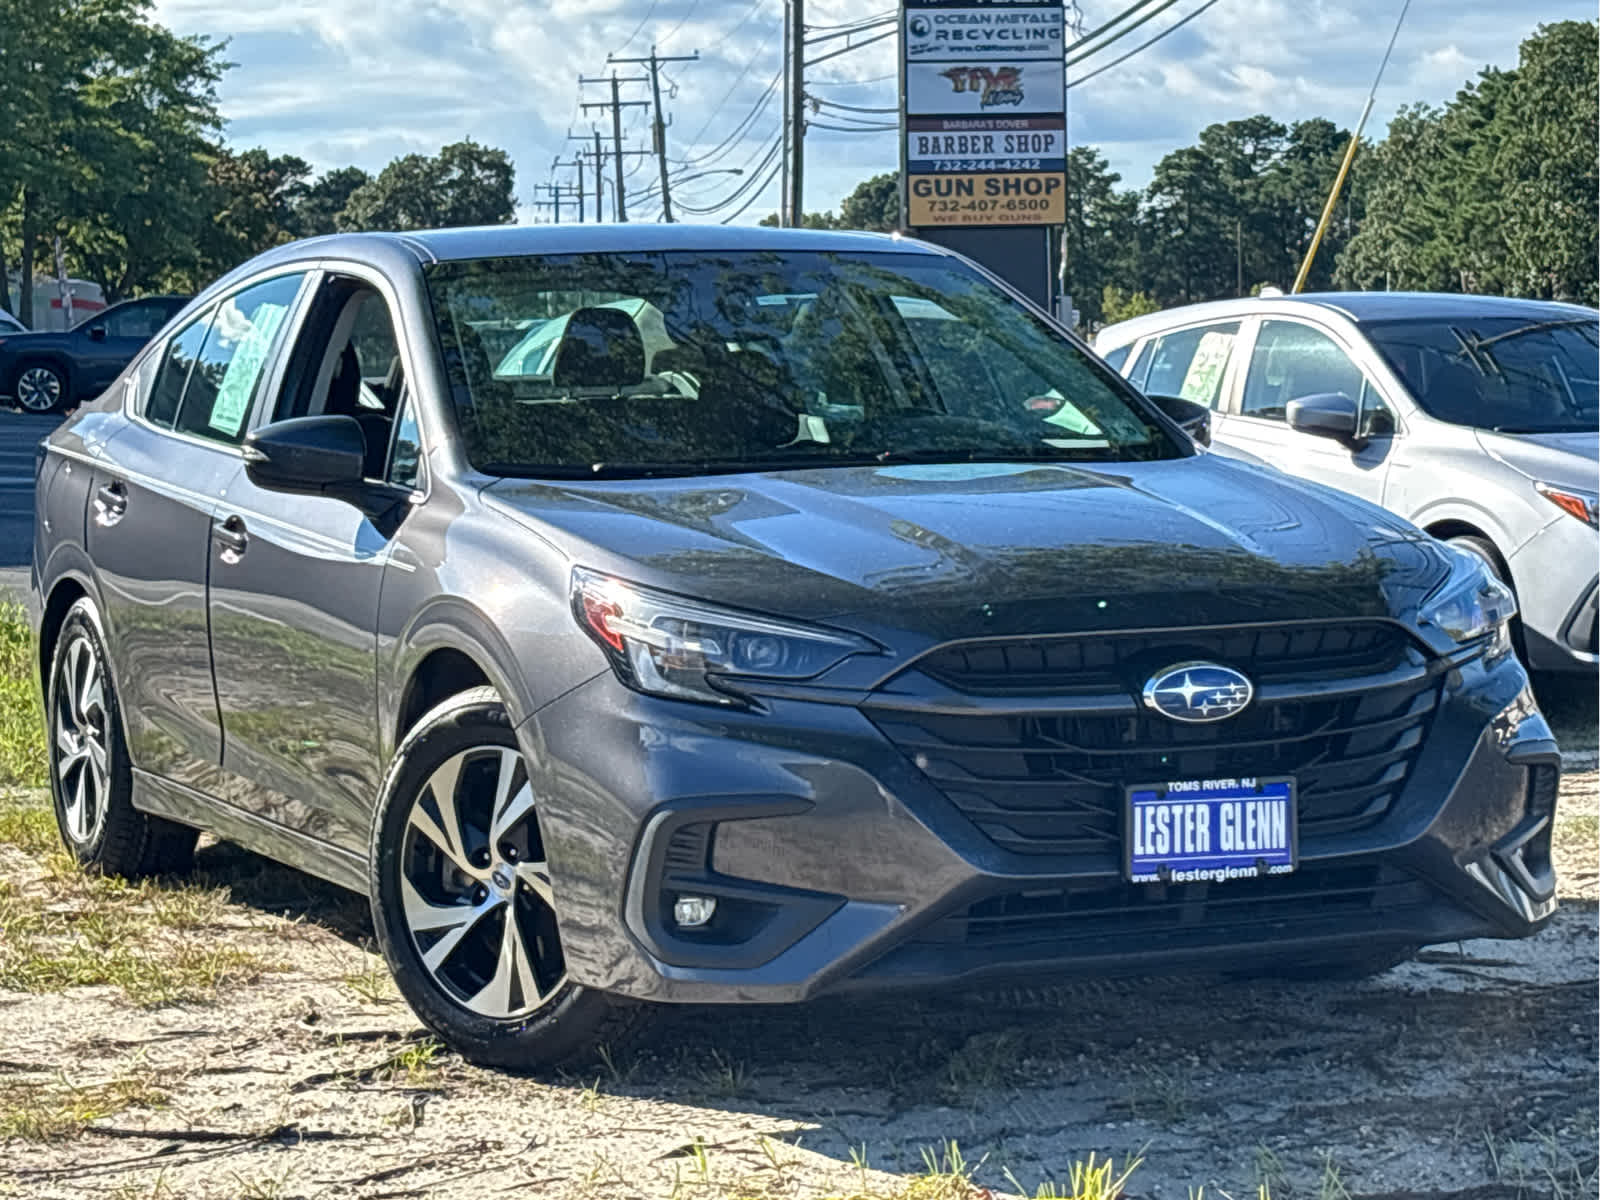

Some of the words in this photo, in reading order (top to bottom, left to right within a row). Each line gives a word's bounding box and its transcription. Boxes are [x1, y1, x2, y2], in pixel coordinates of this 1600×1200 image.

[934, 14, 992, 25] OCEAN
[995, 13, 1061, 24] METALS
[935, 28, 1061, 41] RECYCLING
[943, 120, 994, 129] BARBARA'S
[997, 119, 1029, 128] DOVER
[917, 135, 994, 155] BARBER
[1004, 133, 1055, 153] SHOP
[933, 159, 1041, 171] 732-244-4242
[913, 178, 974, 197] GUN
[984, 177, 1061, 196] SHOP
[928, 199, 1050, 212] 732-407-6500
[933, 215, 955, 223] WE
[962, 214, 992, 222] BUY
[999, 213, 1043, 222] GUNS
[1167, 780, 1200, 792] TOMS
[1241, 777, 1257, 788] NJ
[1133, 803, 1210, 856] LESTER
[1219, 800, 1286, 852] GLENN
[1131, 873, 1160, 883] www.
[1171, 865, 1258, 882] lesterglenn
[1267, 864, 1293, 874] .com
